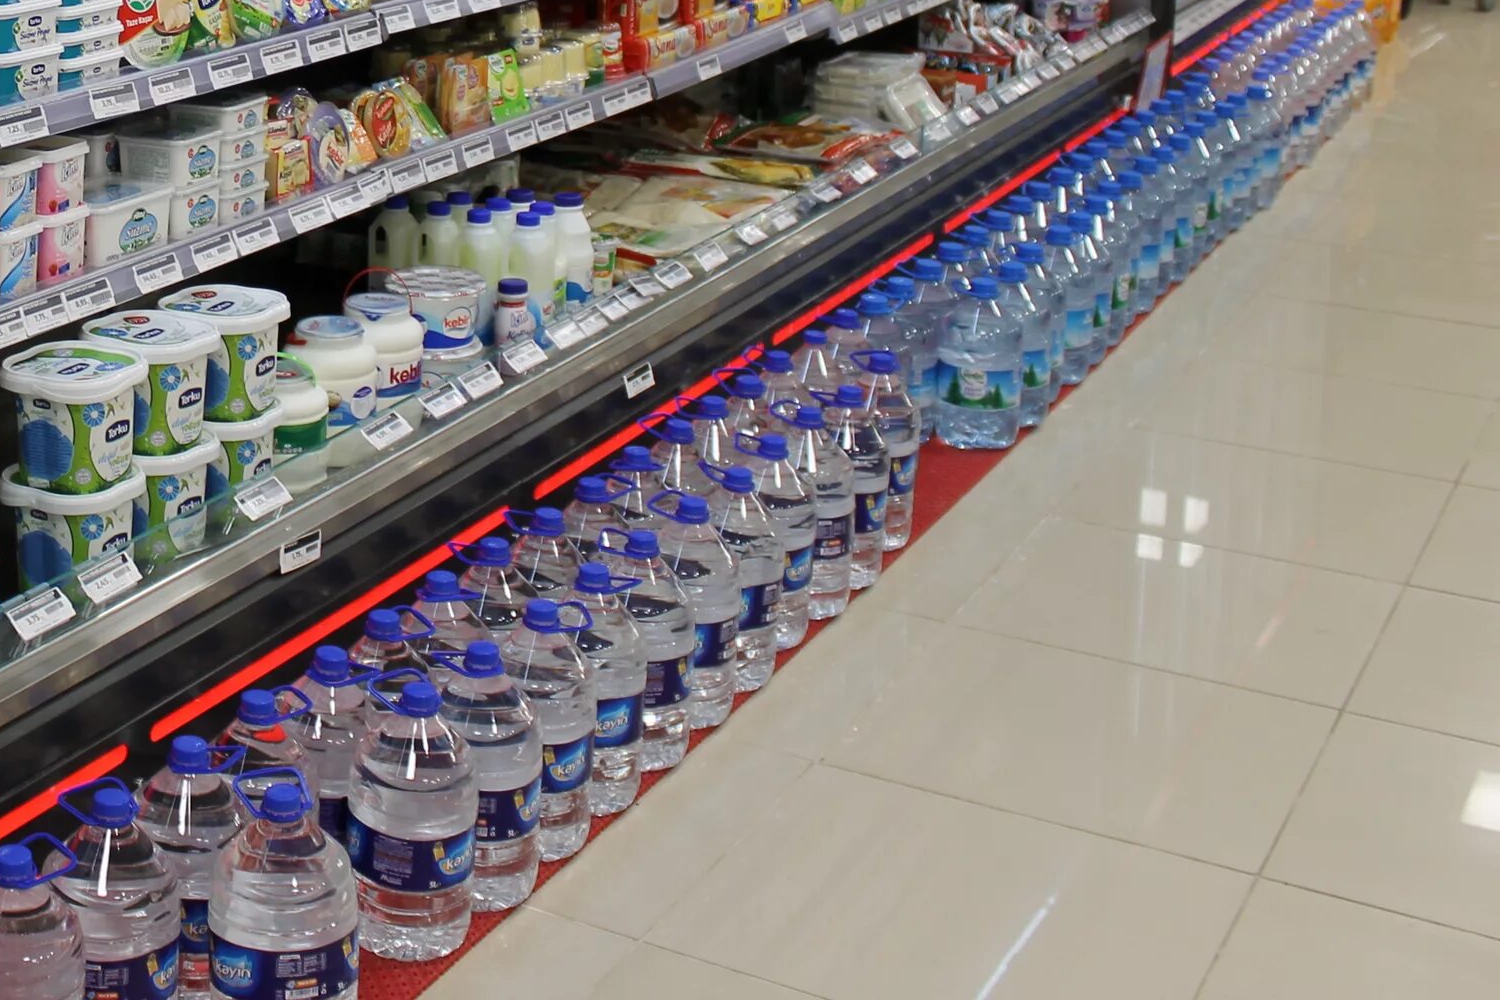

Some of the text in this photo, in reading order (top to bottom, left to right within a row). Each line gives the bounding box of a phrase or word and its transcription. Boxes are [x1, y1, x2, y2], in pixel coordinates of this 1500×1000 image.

[126, 18, 140, 27] Taze
[191, 158, 215, 170] Süzme
[125, 223, 154, 241] Süzme
[443, 315, 470, 330] kebir
[257, 358, 276, 373] Torku
[180, 391, 201, 406] Torku
[107, 424, 129, 440] Torku
[214, 959, 252, 980] kayın
